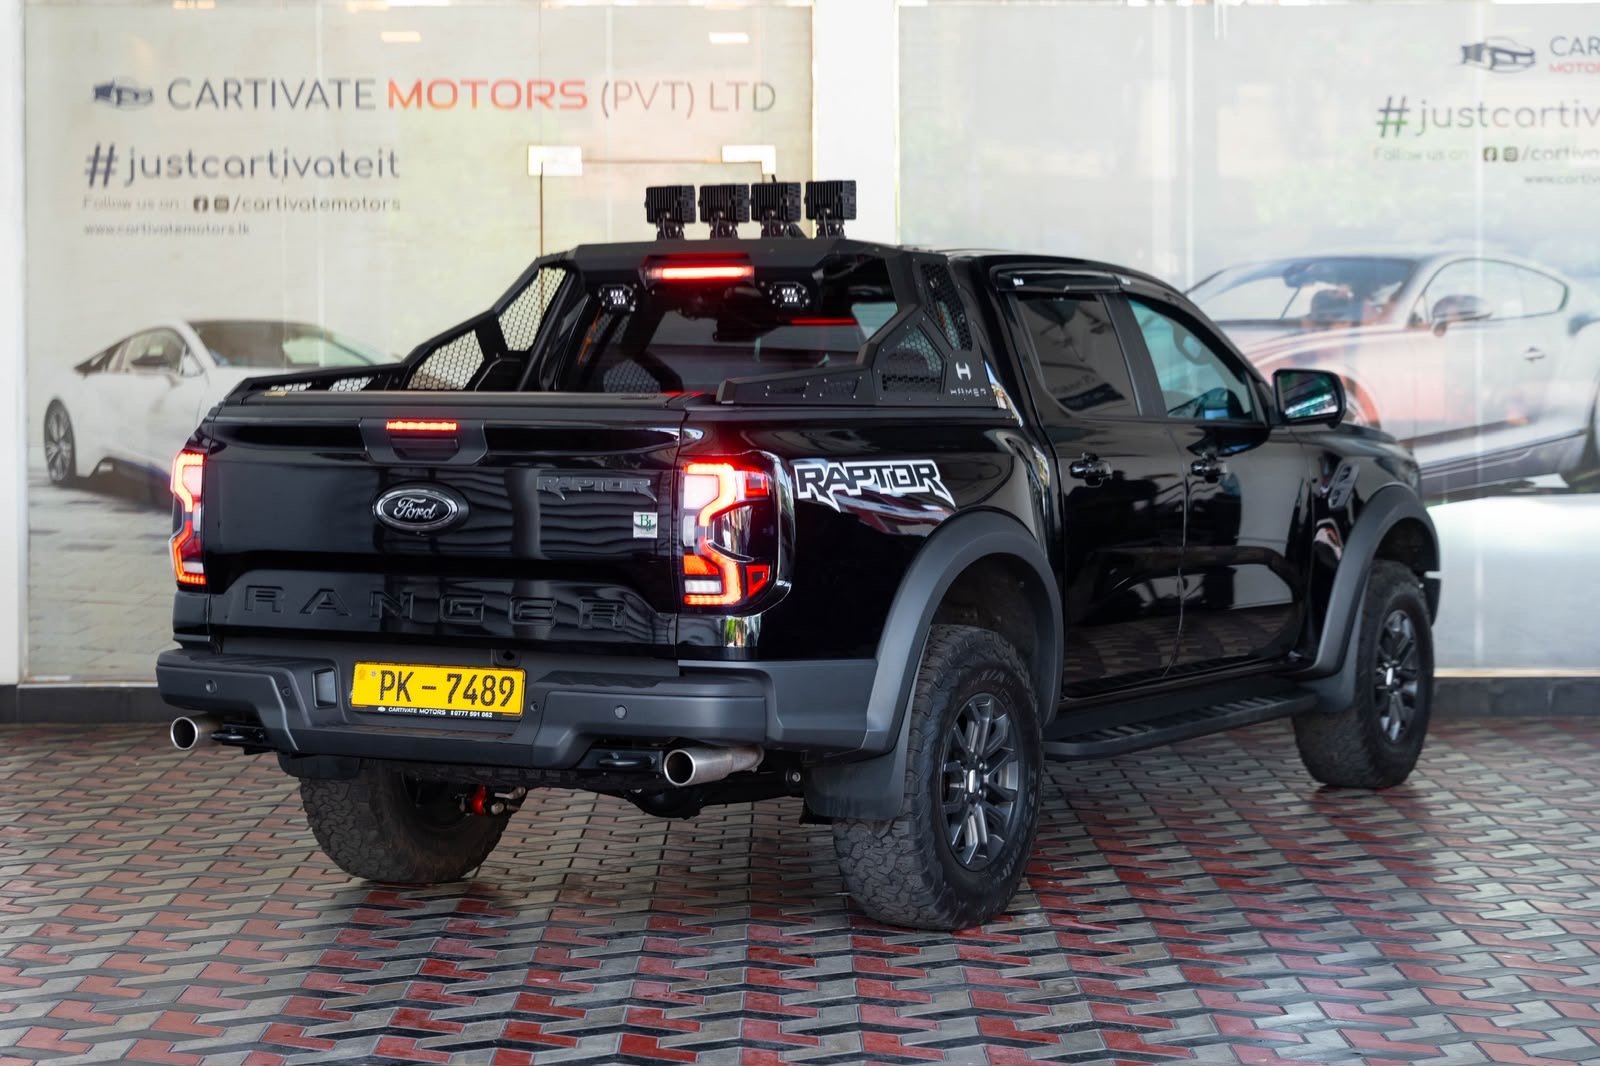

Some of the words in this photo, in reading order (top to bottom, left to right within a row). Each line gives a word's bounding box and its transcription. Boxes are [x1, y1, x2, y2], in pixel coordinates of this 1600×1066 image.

[167, 77, 377, 111] CARTIVATE
[388, 79, 588, 111] MOTORS
[600, 80, 696, 118] (PVT)
[709, 80, 777, 112] LTD
[84, 142, 401, 189] #justcartivateit
[536, 475, 658, 503] RAPTOR
[793, 459, 956, 512] RAPTOR
[393, 497, 436, 521] Ford
[244, 584, 629, 629] RANGER
[388, 706, 418, 714] CARTIVATE
[418, 708, 447, 716] MOTORS
